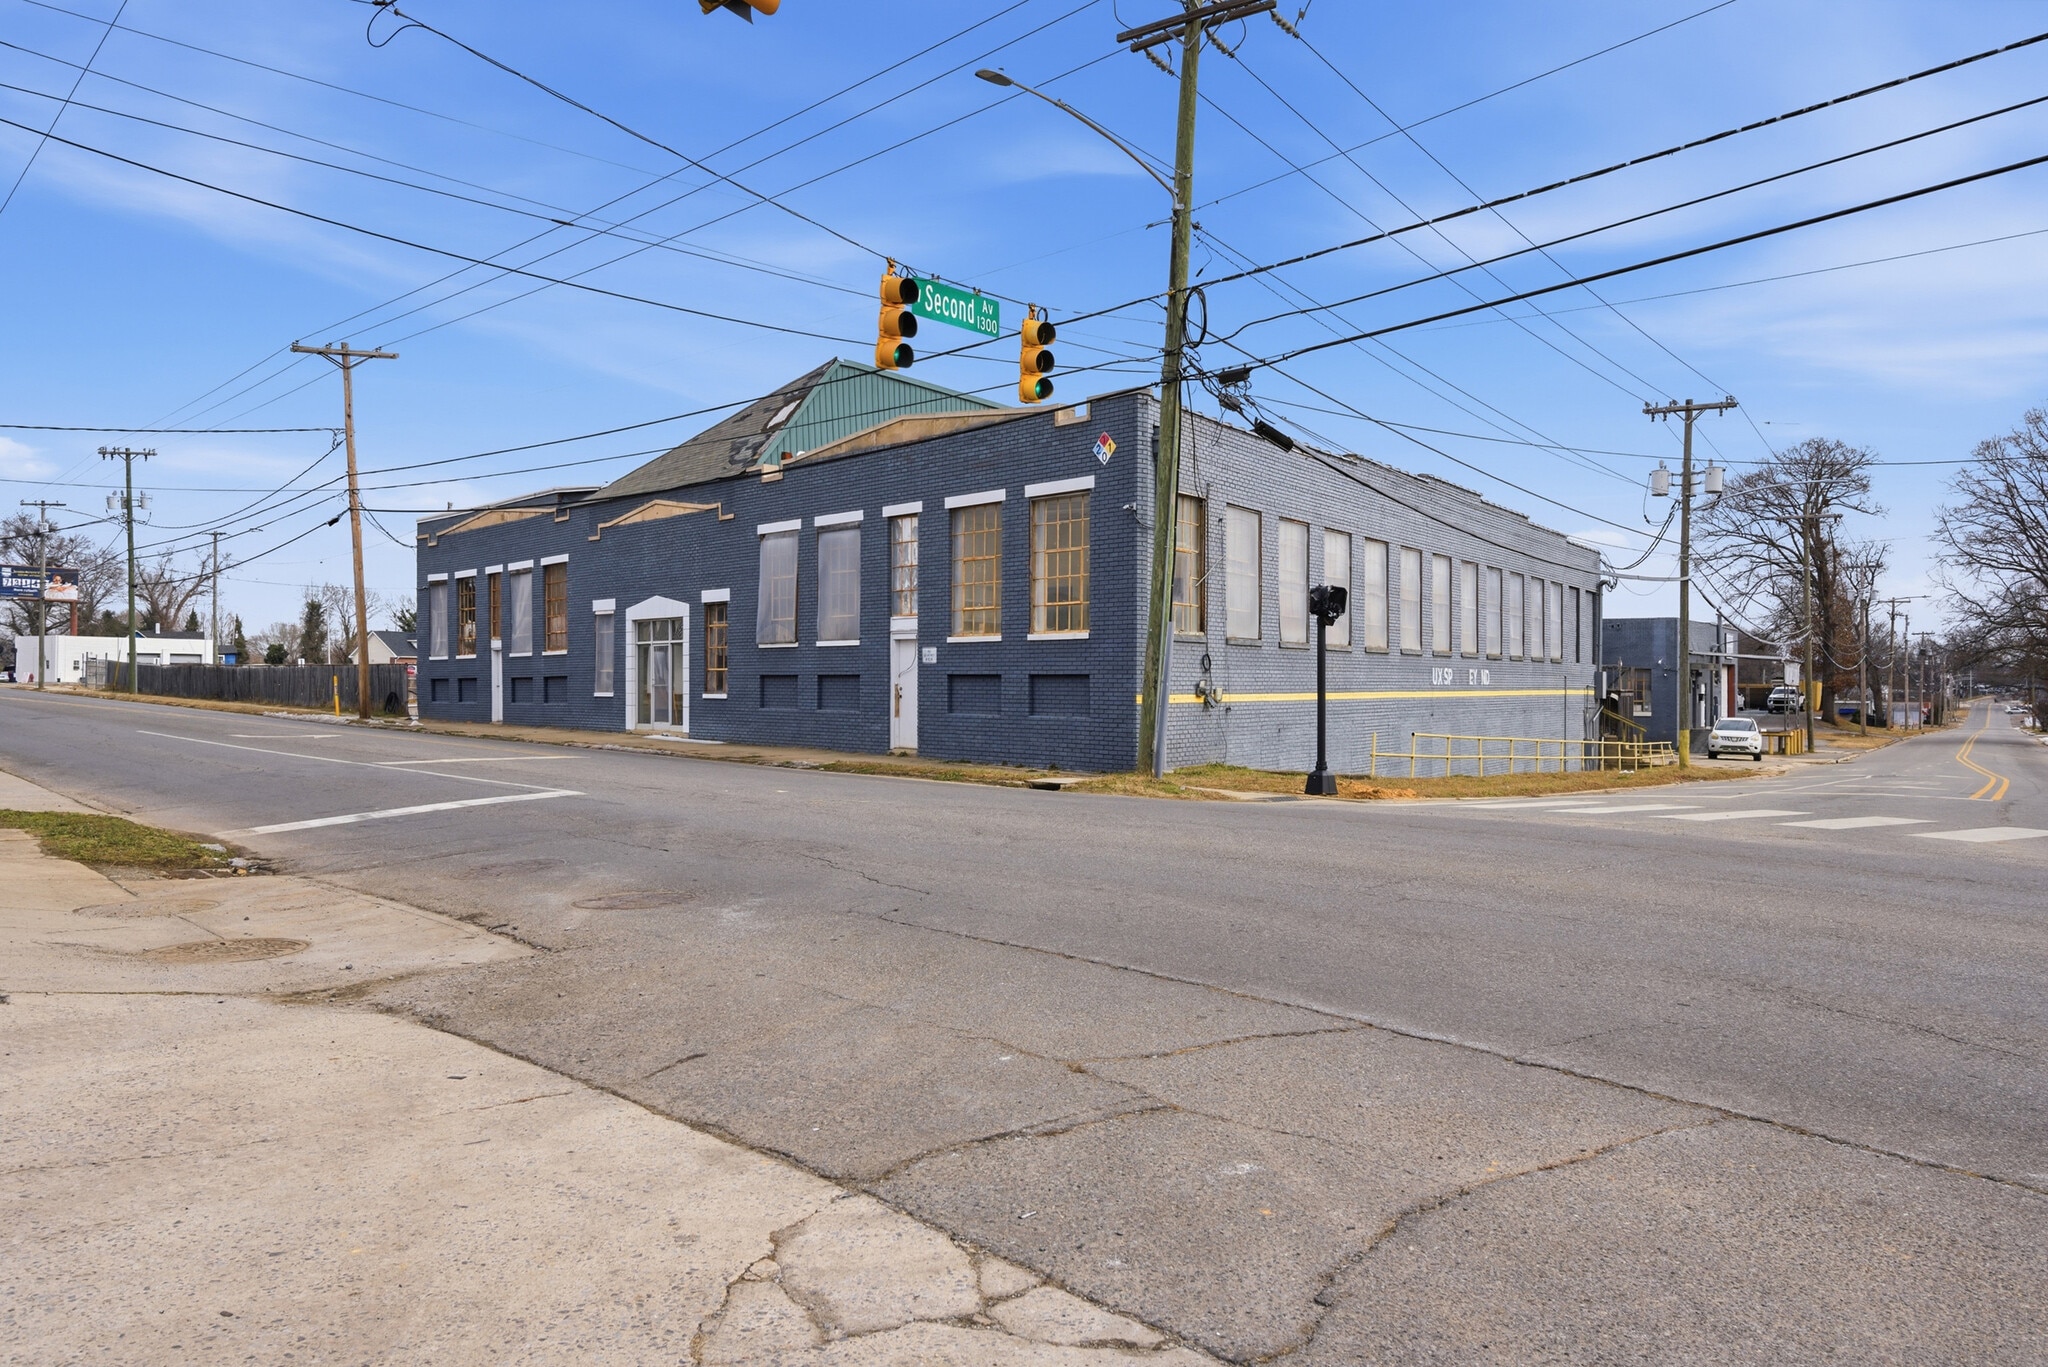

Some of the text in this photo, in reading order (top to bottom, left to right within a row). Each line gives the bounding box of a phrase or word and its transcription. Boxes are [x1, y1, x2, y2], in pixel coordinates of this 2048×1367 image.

[924, 284, 975, 324] Second
[982, 300, 993, 315] Av
[976, 315, 998, 334] 1300
[1096, 442, 1112, 455] 2 1
[1102, 451, 1107, 462] 0
